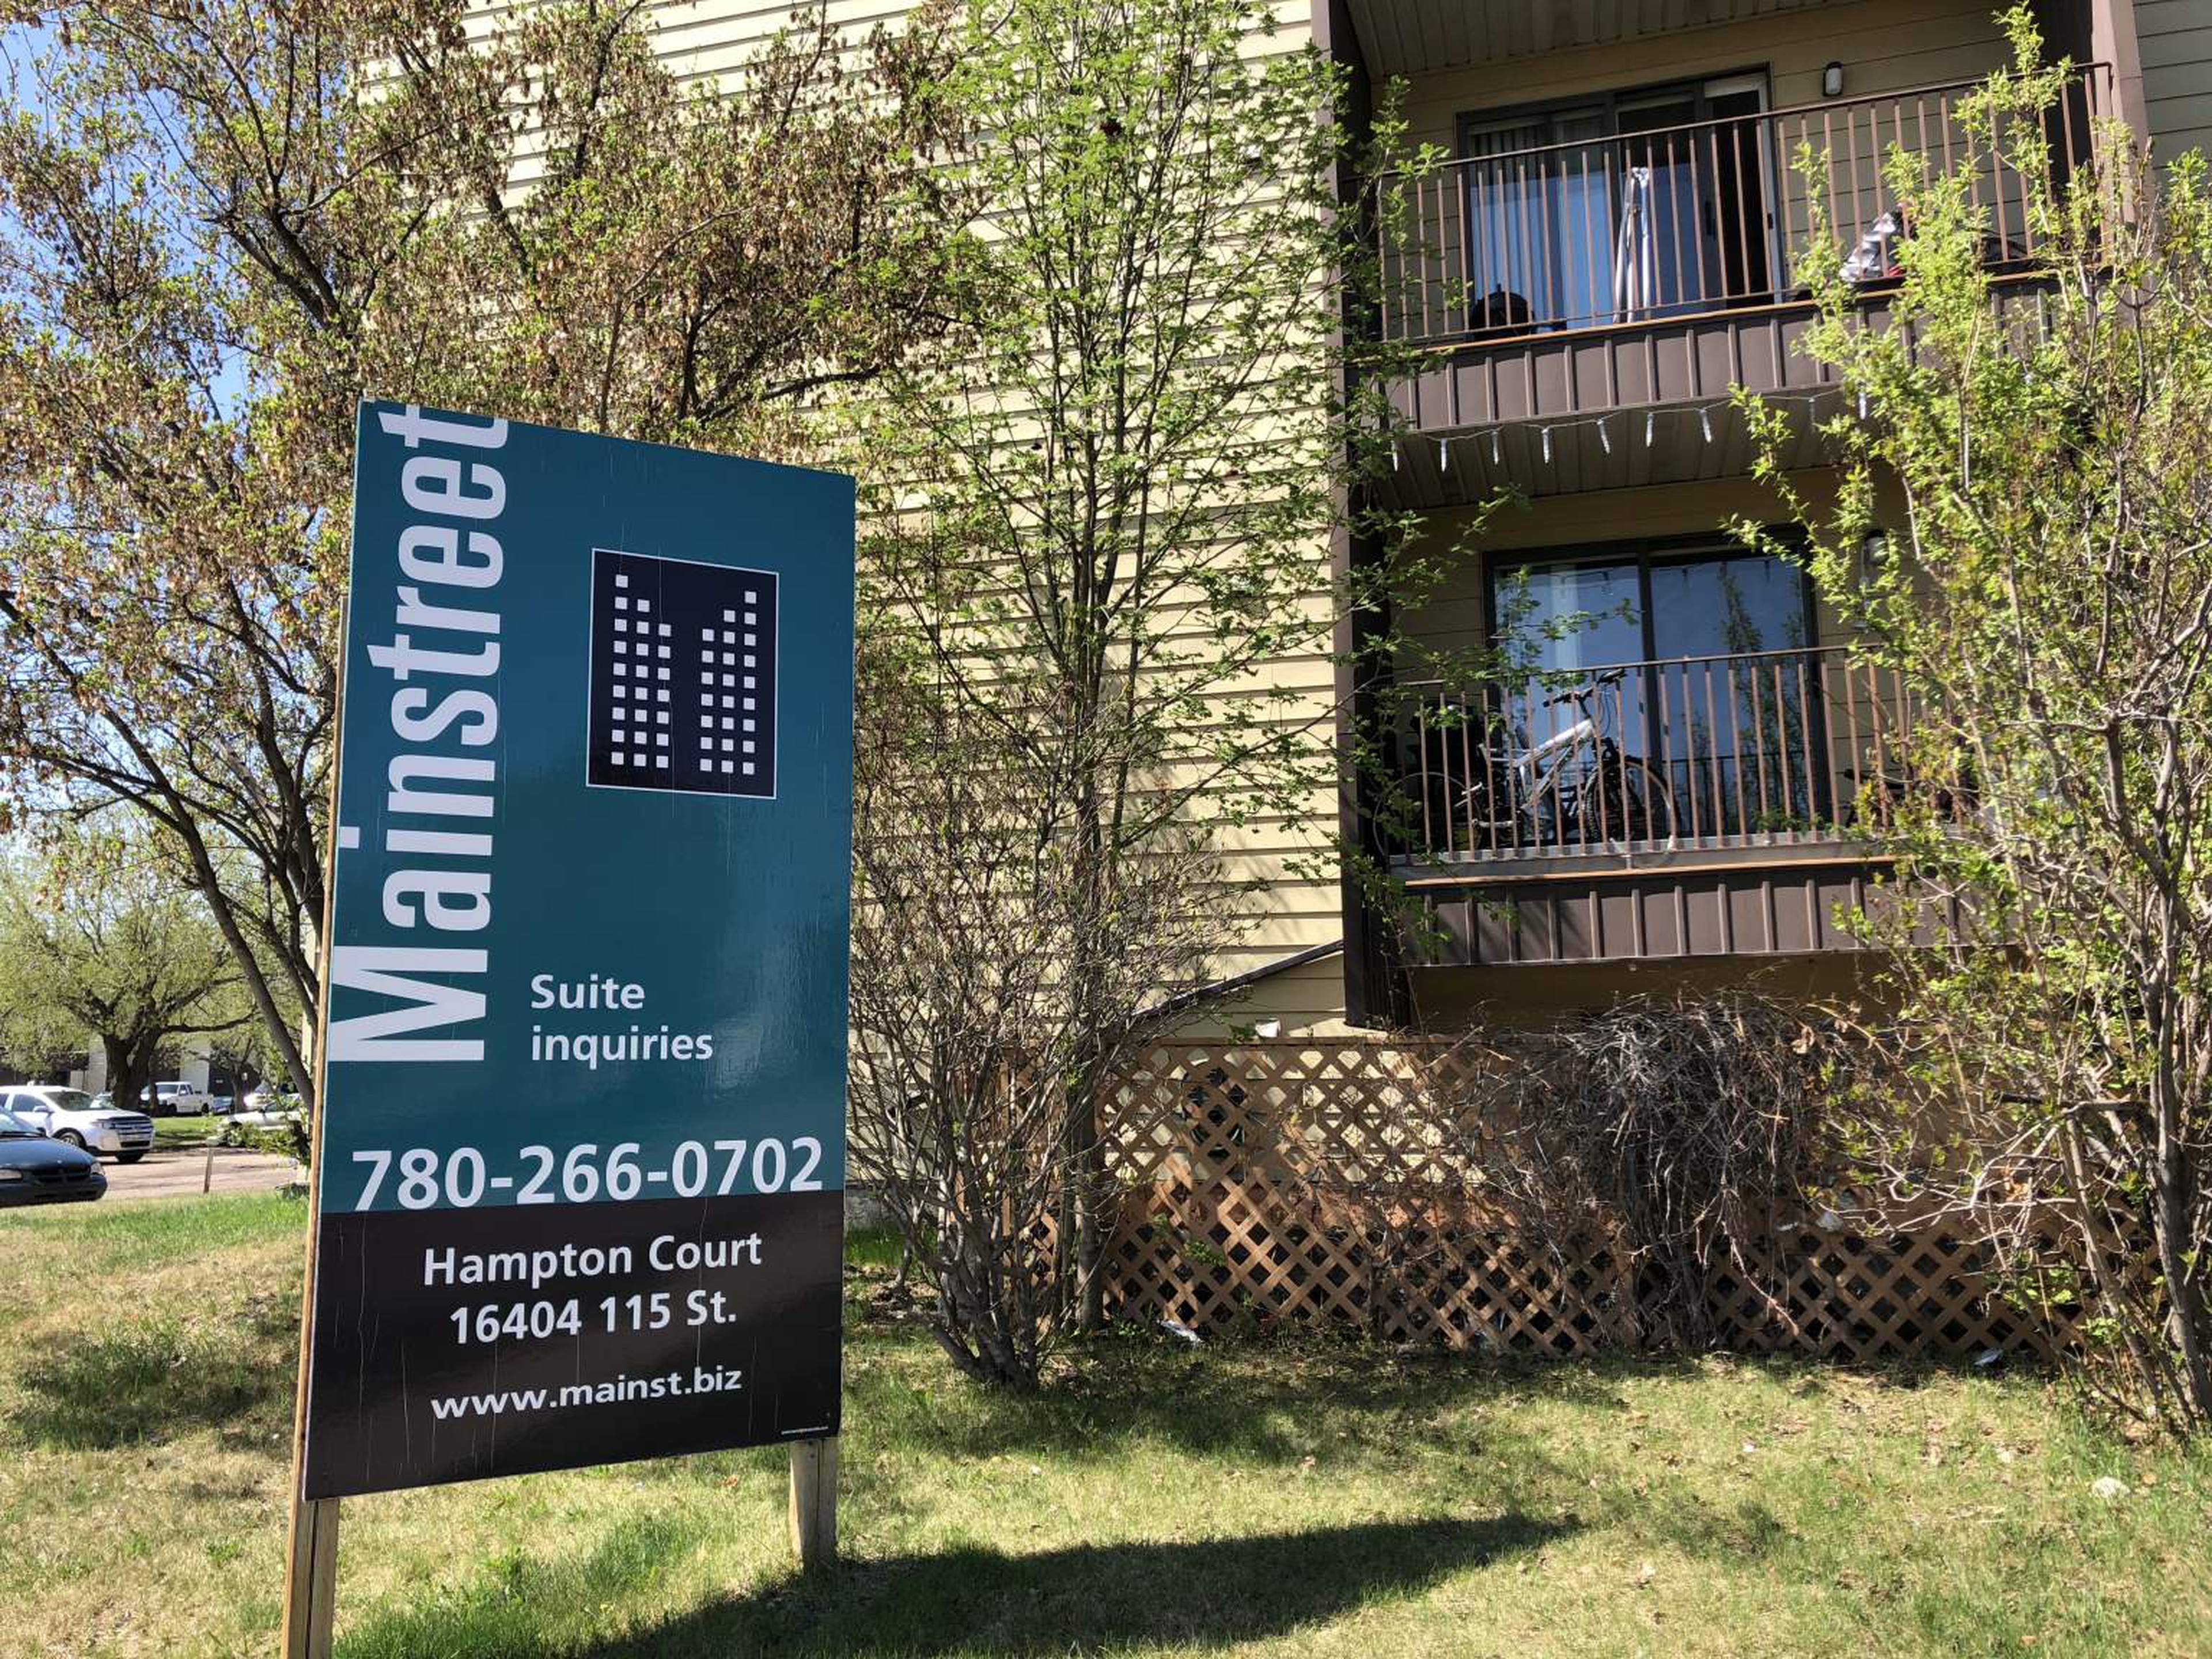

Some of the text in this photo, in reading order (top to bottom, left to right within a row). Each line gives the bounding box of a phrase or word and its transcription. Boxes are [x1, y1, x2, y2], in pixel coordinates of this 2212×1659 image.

[328, 404, 508, 1061] Mainstreet
[531, 974, 645, 1009] Suite
[532, 1025, 713, 1070] inquiries
[352, 1137, 823, 1211] 780-266-0702
[424, 1233, 763, 1289] Hampton Court
[450, 1290, 736, 1344] 16404 115 St.
[431, 1365, 742, 1419] www.mainst.biz
